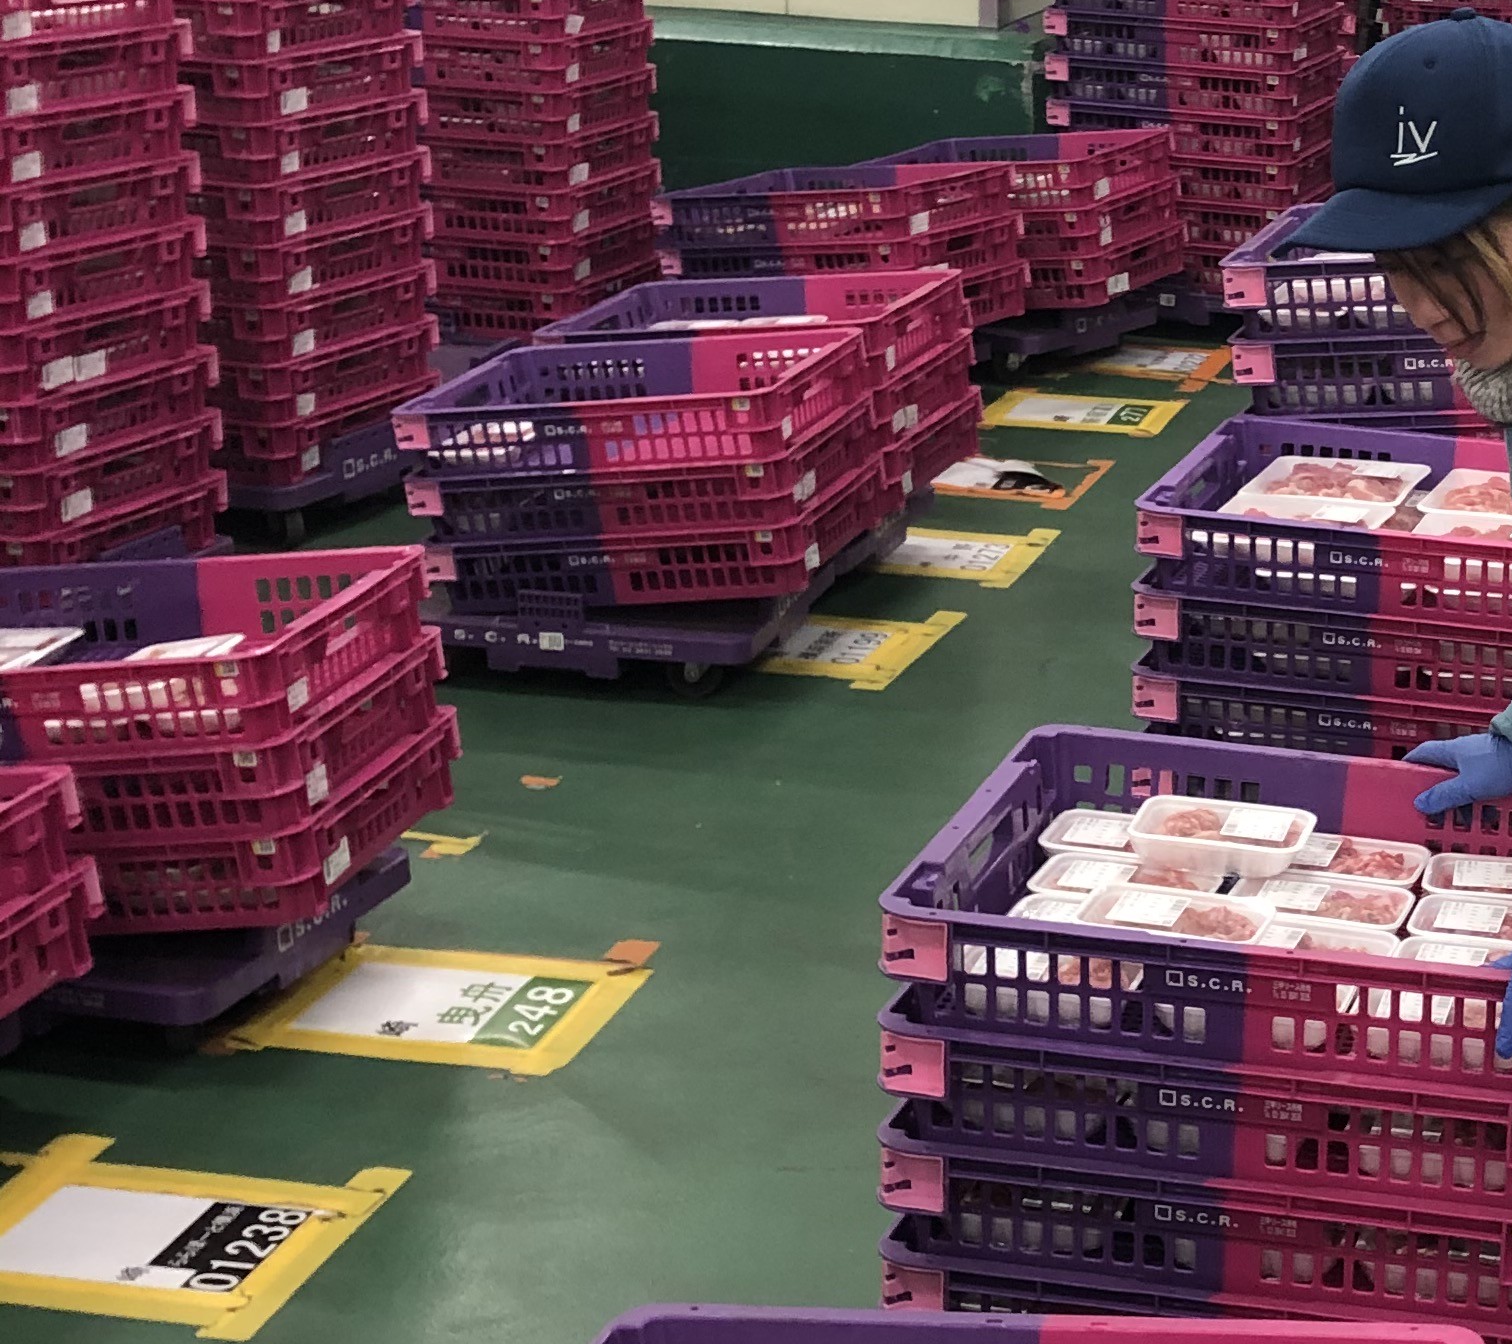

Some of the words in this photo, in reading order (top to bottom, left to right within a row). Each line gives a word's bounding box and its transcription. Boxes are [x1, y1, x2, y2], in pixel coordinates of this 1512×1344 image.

[1344, 554, 1389, 568] S.C.R.
[1337, 635, 1382, 649] S.C.R.
[1333, 717, 1378, 732] S.C.R.
[1187, 973, 1253, 994] S.C.R.
[508, 985, 575, 1036] 248
[1180, 1093, 1244, 1113] S.C.R.
[1175, 1208, 1239, 1229] S.C.R.
[189, 1208, 308, 1291] 01238
